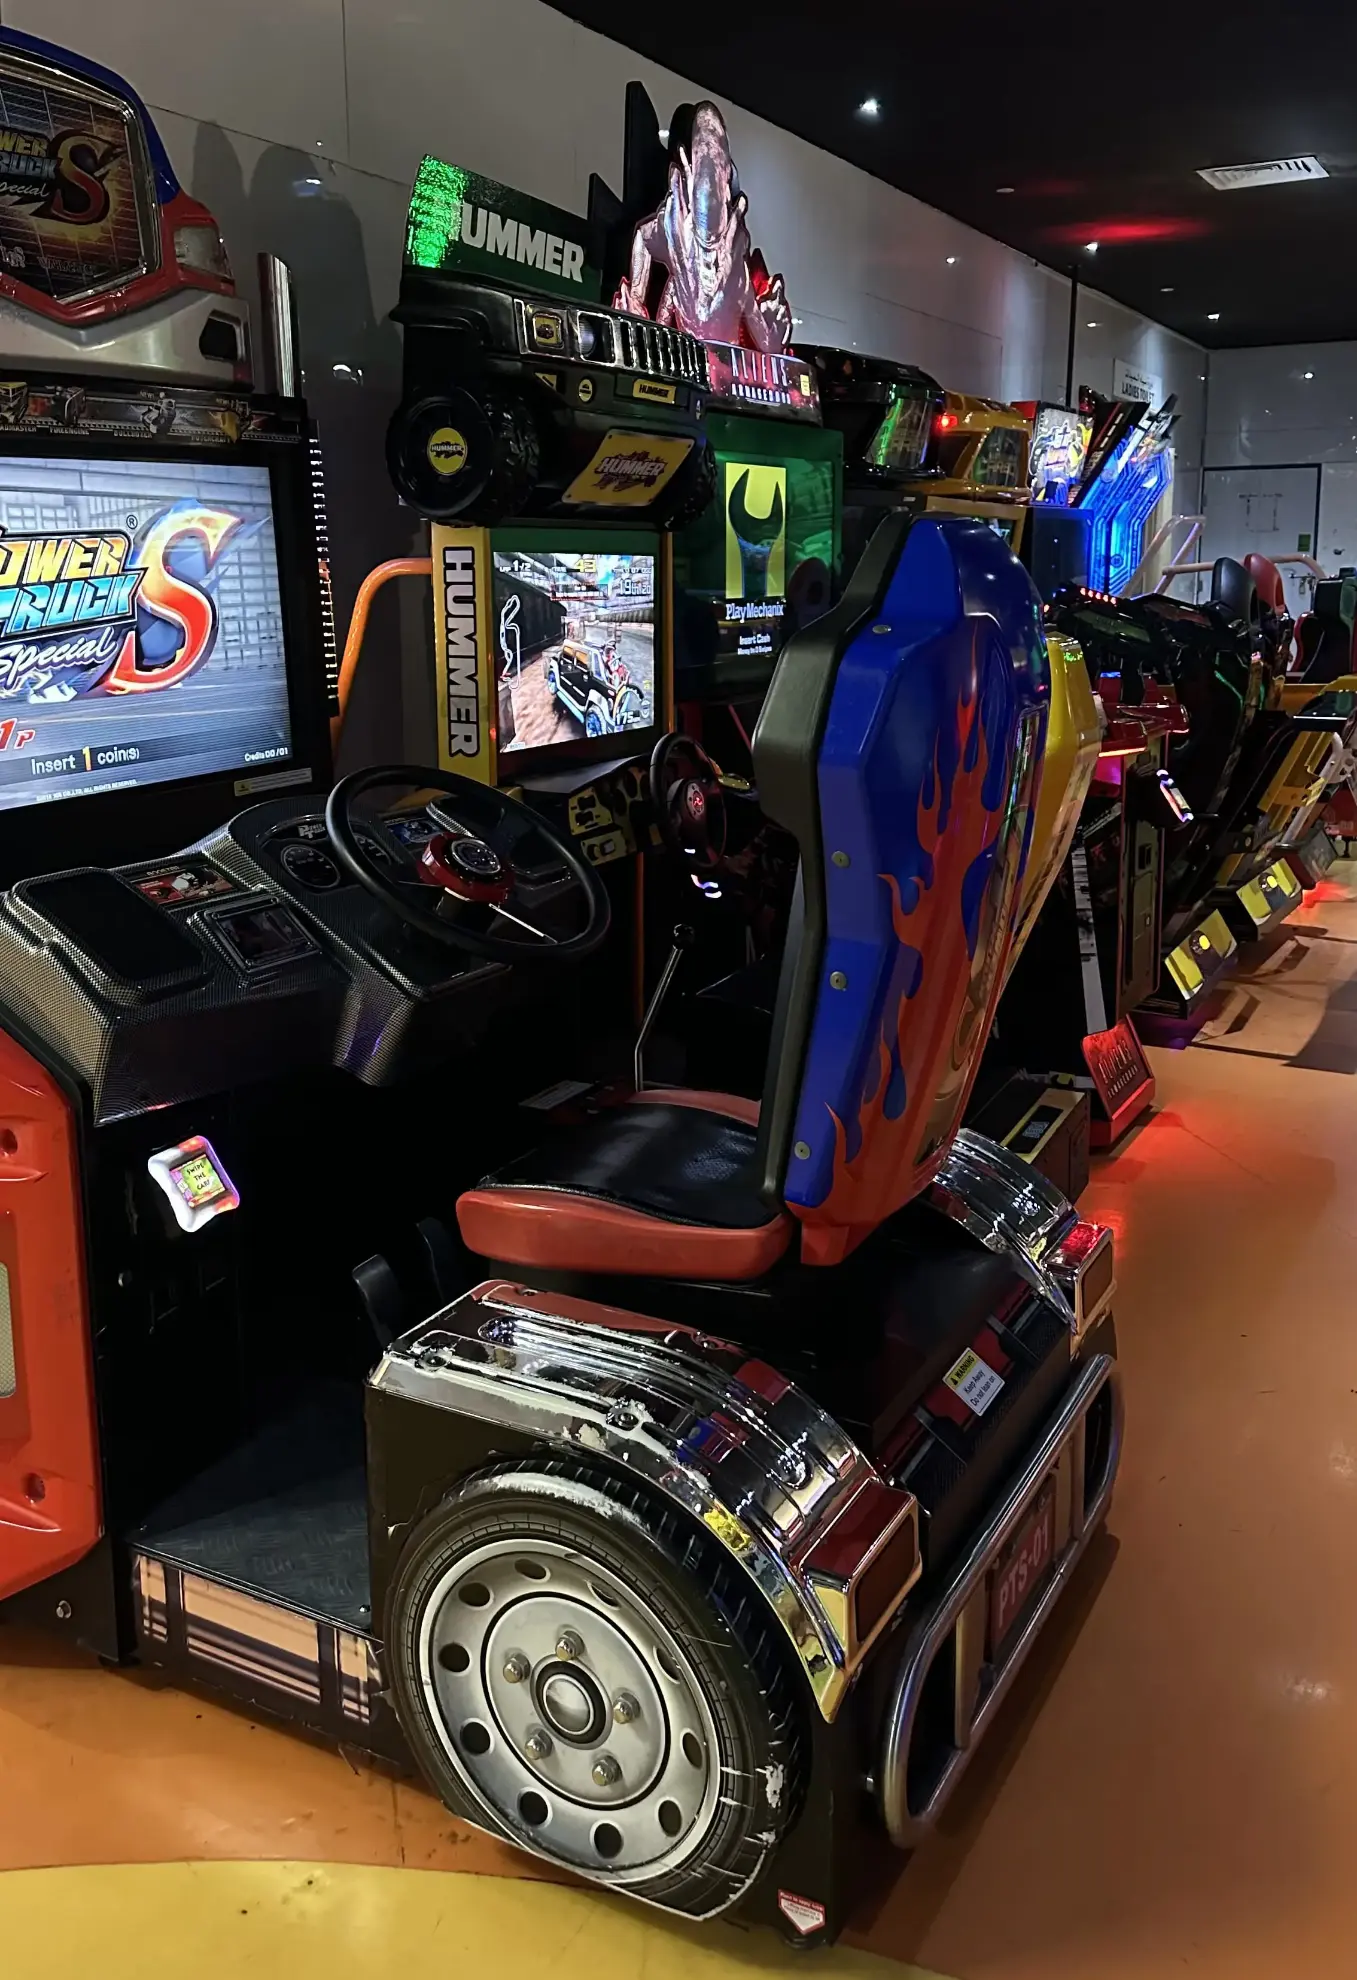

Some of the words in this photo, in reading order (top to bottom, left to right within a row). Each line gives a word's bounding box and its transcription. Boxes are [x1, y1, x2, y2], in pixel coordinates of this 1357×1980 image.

[731, 348, 788, 387] ALIENS
[638, 384, 669, 398] HUMMER
[431, 444, 463, 452] HUMMER
[597, 457, 665, 477] HUMMER
[574, 558, 597, 573] 43
[442, 546, 480, 758] HUMMER
[31, 754, 76, 775] Insert
[82, 745, 93, 773] 1
[97, 746, 140, 765] coin(s)
[186, 1162, 204, 1175] SWIPE
[193, 1172, 207, 1181] THE
[954, 1355, 975, 1379] WARNING
[963, 1380, 976, 1394] Keep
[971, 1369, 986, 1384] Away
[969, 1397, 980, 1407] Do
[976, 1389, 985, 1400] not
[999, 1513, 1048, 1628] PTS-01
